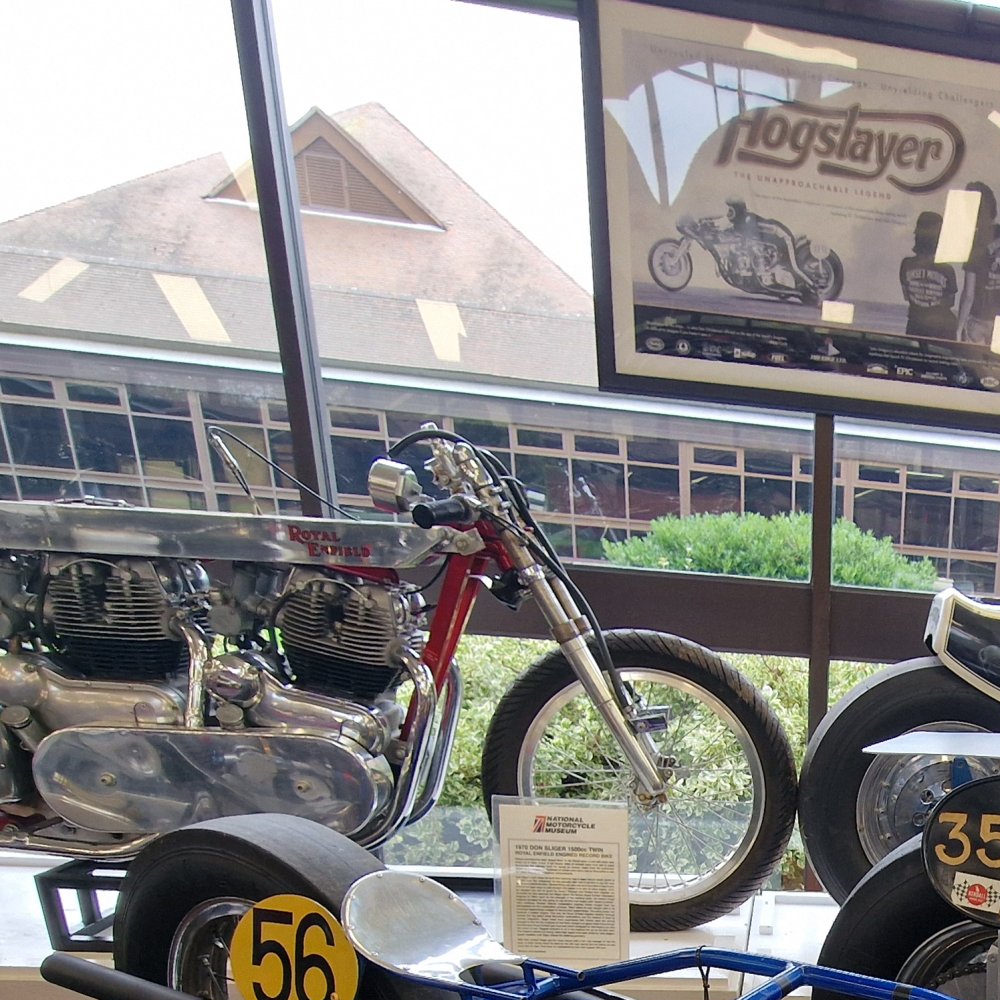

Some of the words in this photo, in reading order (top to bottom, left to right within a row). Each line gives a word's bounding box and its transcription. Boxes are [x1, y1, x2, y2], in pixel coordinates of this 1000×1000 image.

[715, 103, 960, 191] Hogslayer
[287, 525, 341, 544] ROYAL
[307, 542, 373, 558] ENFIELD
